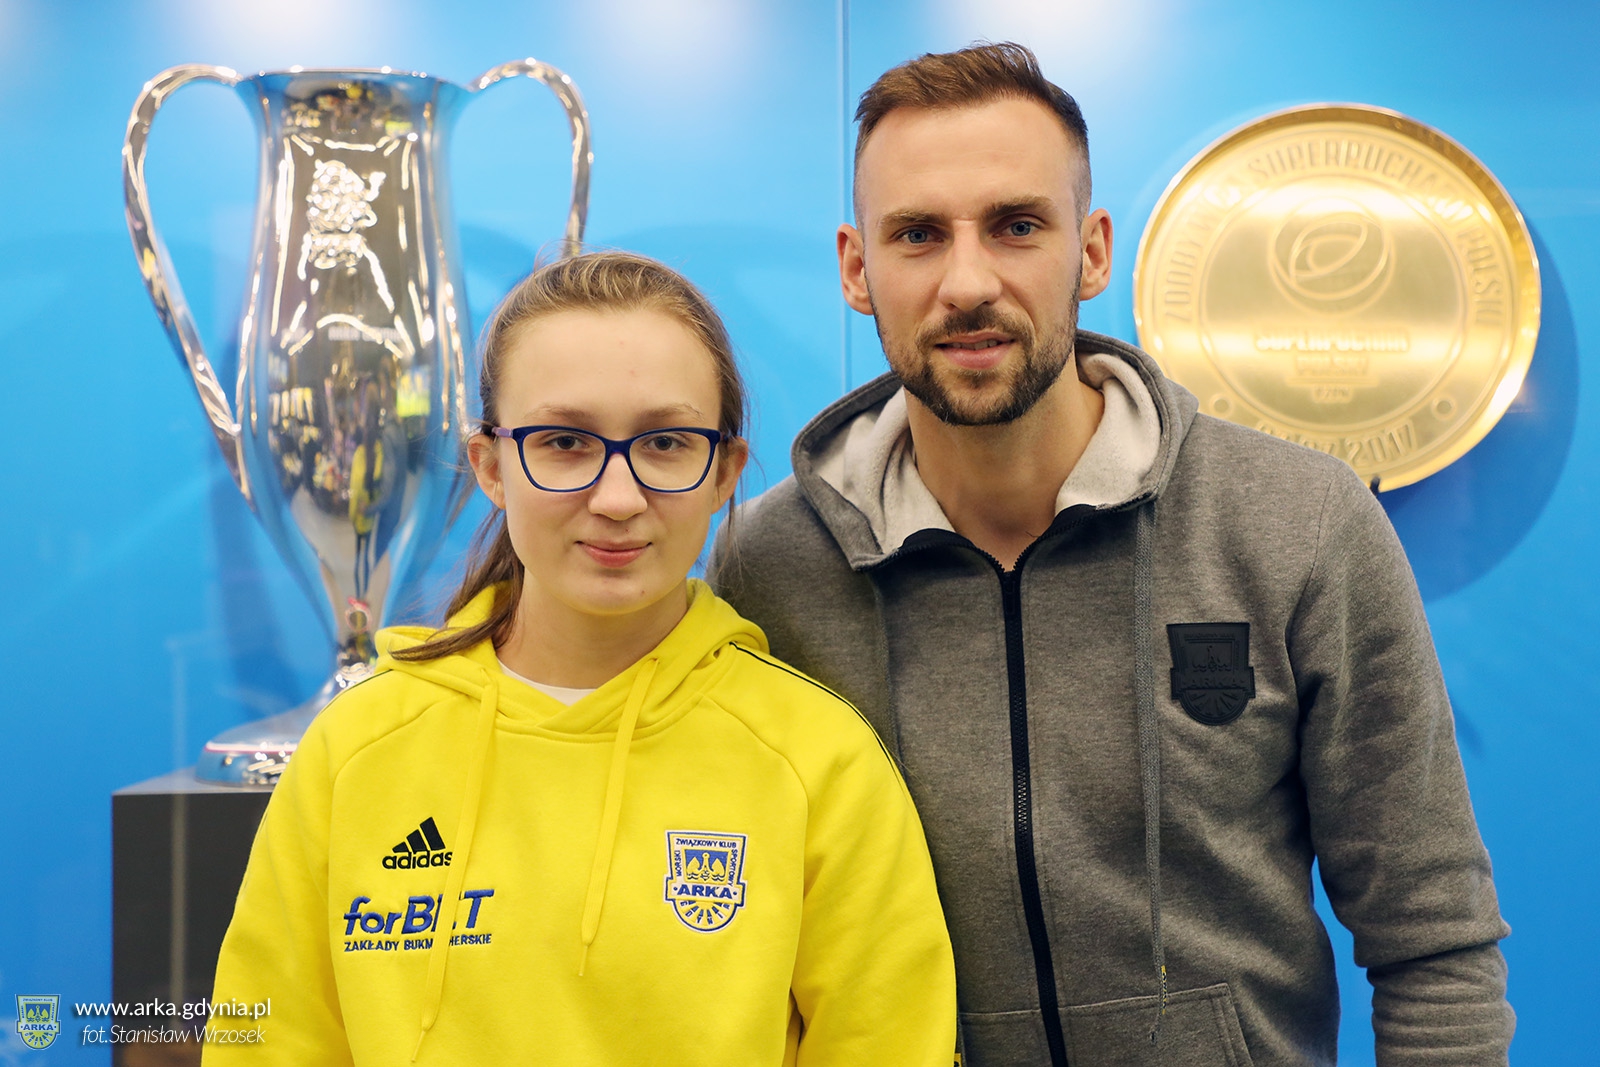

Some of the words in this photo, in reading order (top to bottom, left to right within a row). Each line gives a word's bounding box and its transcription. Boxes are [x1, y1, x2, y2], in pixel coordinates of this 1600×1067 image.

[1457, 226, 1503, 326] POLSKI
[1344, 416, 1418, 467] 2017
[676, 838, 718, 847] ZWIĄZKOWY
[382, 850, 453, 869] adidas
[727, 849, 738, 887] SPORTOWY
[677, 884, 733, 899] ARKA
[343, 888, 495, 935] forBT
[344, 939, 399, 952] ZAKŁADY
[403, 933, 492, 950] BUKMHERSKIE
